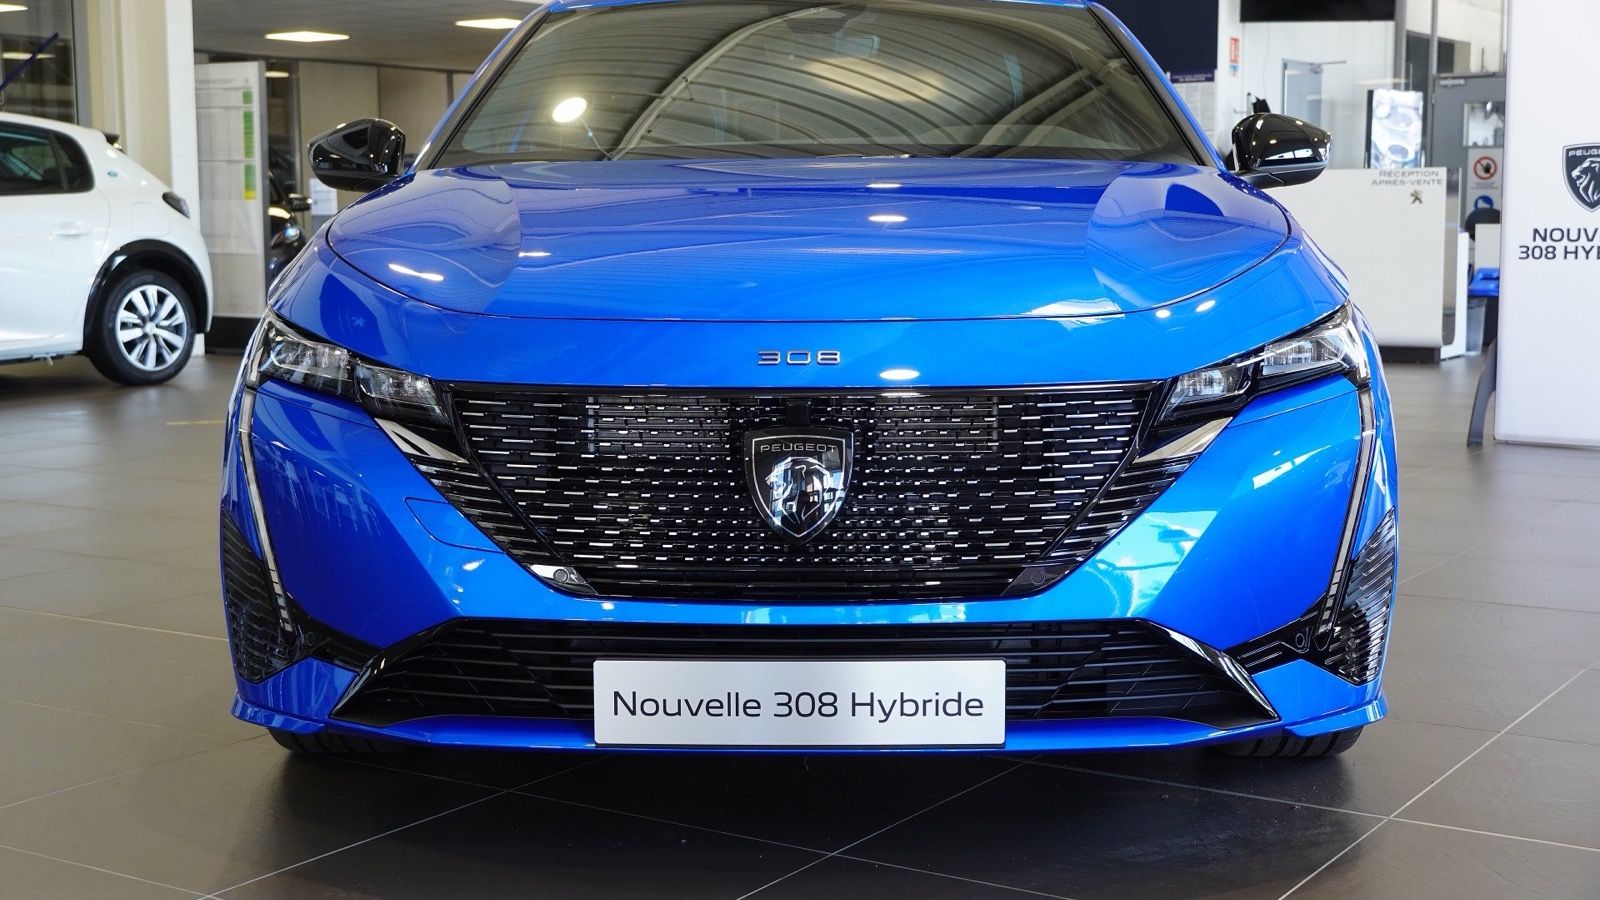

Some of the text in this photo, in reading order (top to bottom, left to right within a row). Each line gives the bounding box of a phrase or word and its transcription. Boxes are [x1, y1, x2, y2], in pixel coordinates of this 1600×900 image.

[1568, 148, 1600, 157] PEUG
[1532, 227, 1600, 242] NOUV
[1518, 245, 1600, 260] 308 HY
[758, 350, 841, 365] 308
[760, 442, 837, 453] PEUGEOT
[613, 690, 984, 723] Nouvelle 308 Hybride
